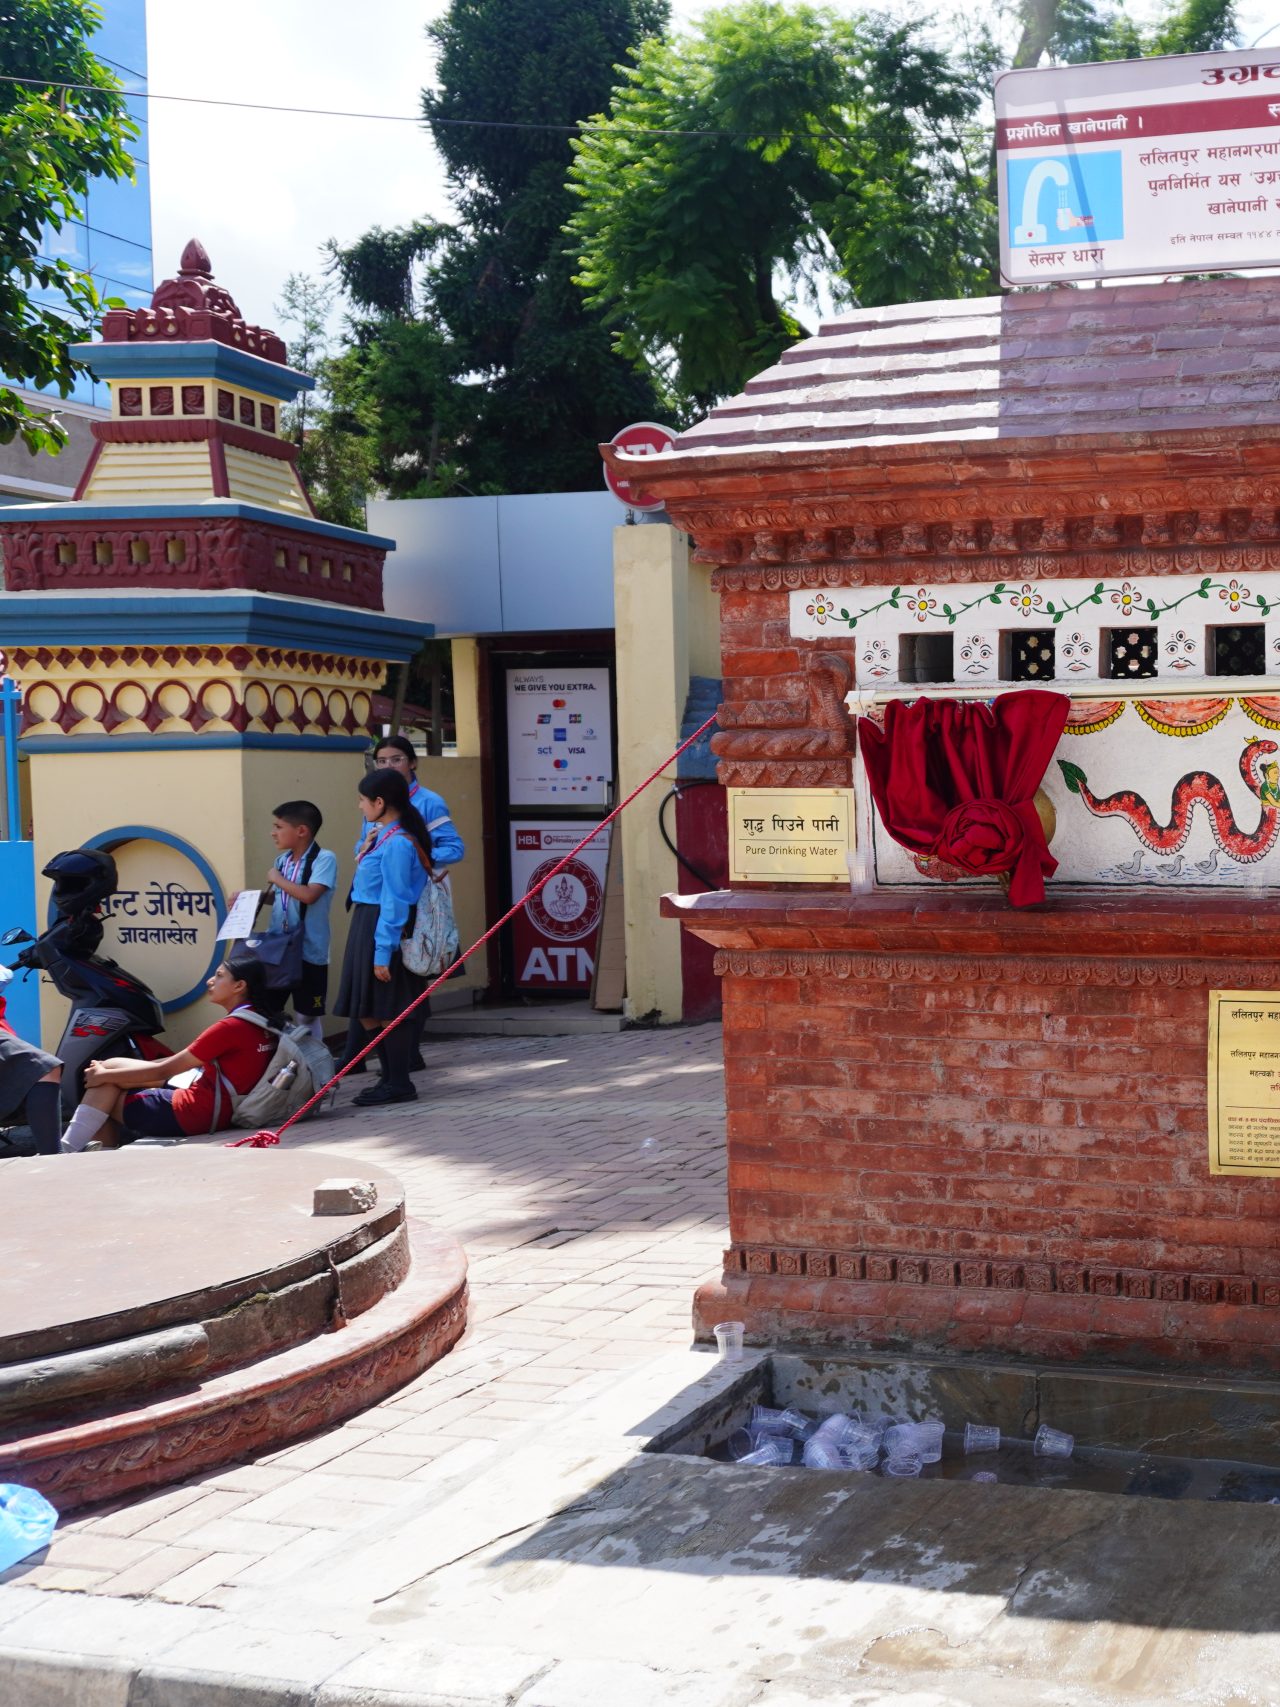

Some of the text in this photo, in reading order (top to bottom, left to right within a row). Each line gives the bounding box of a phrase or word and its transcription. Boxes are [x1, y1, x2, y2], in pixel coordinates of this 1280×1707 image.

[1006, 117, 1060, 141] प्रशोधित
[1068, 114, 1128, 135] खानेपानी
[1139, 148, 1200, 167] ललितपुर
[1219, 173, 1241, 187] यस
[1208, 196, 1268, 216] खानेपानी
[1170, 234, 1186, 246] इति
[1190, 232, 1213, 243] नेपाल
[1217, 231, 1243, 241] सम्वत
[1028, 247, 1105, 268] सेन्सर धारा
[514, 675, 544, 683] ALWAYS
[514, 684, 526, 692] WE
[549, 683, 565, 691] YOU
[742, 814, 840, 836] शुद्ध पिउने पानी
[518, 835, 539, 845] HBL
[745, 846, 838, 857] Pure Drinking Water
[144, 881, 217, 917] जेभिय
[117, 920, 198, 945] जावलाखेल
[1231, 1008, 1264, 1022] ललितपुर
[1230, 1049, 1256, 1060] ललितपुर
